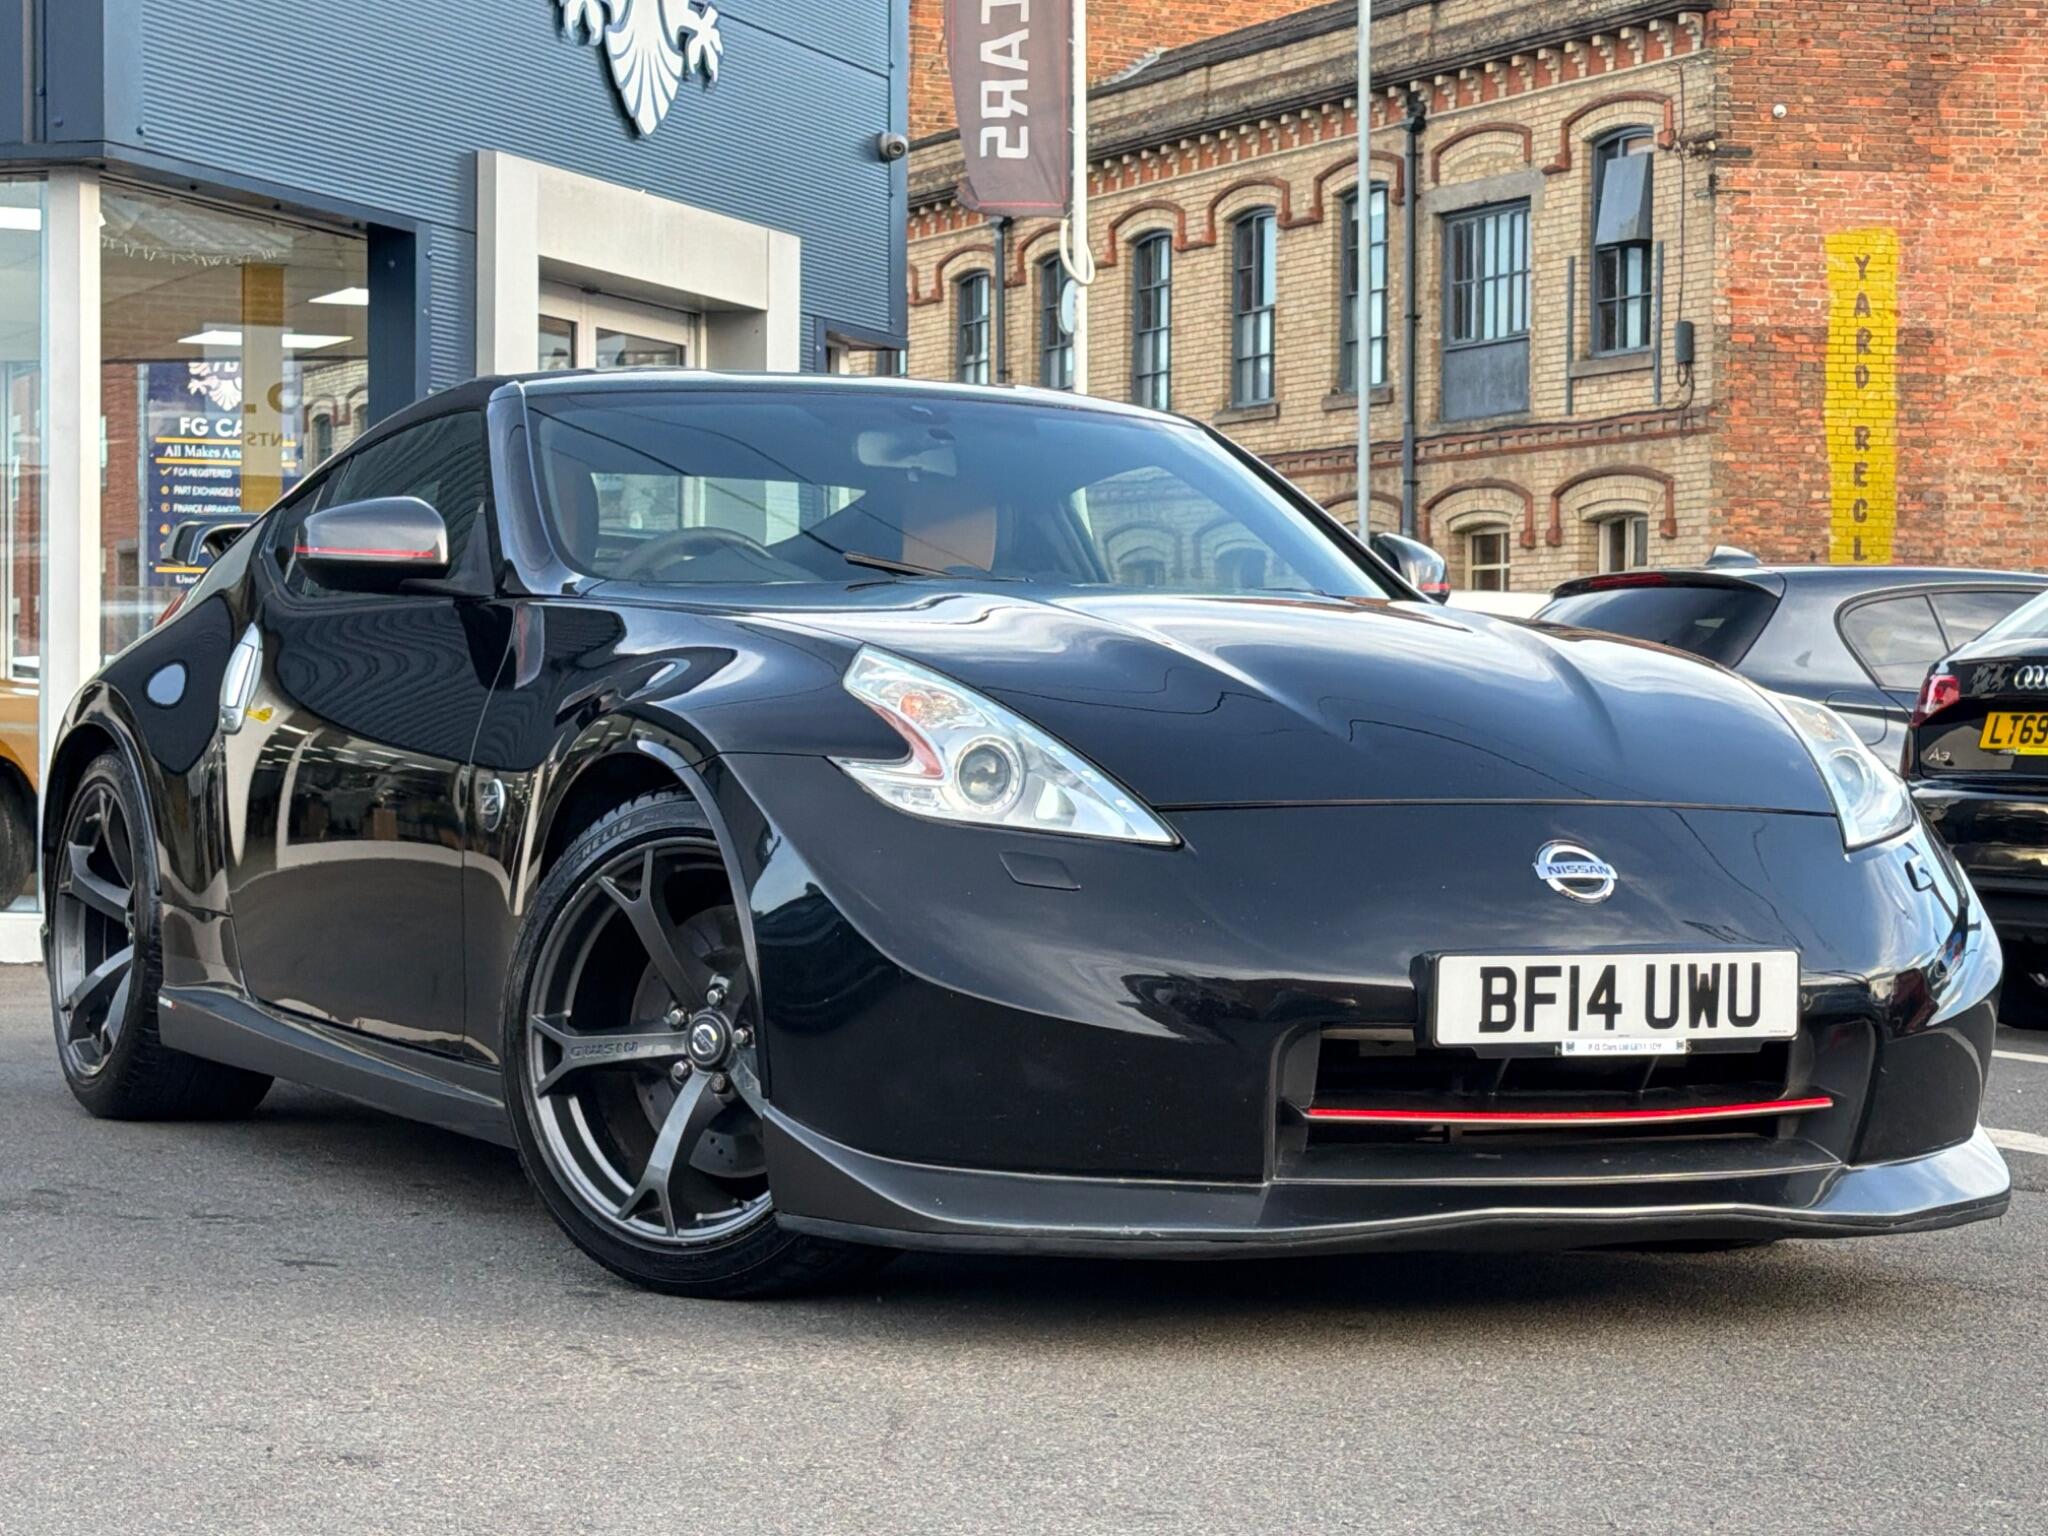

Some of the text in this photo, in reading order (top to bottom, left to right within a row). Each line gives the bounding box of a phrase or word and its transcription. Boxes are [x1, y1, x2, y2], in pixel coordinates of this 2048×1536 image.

[1853, 254, 1872, 561] YARD RECL
[180, 417, 209, 436] FG
[164, 445, 181, 457] All
[184, 445, 220, 458] Makes
[1989, 715, 2048, 744] LT69
[1928, 748, 1951, 761] A3
[1547, 865, 1611, 875] NISSAN
[1478, 962, 1761, 1033] BF14 UWU
